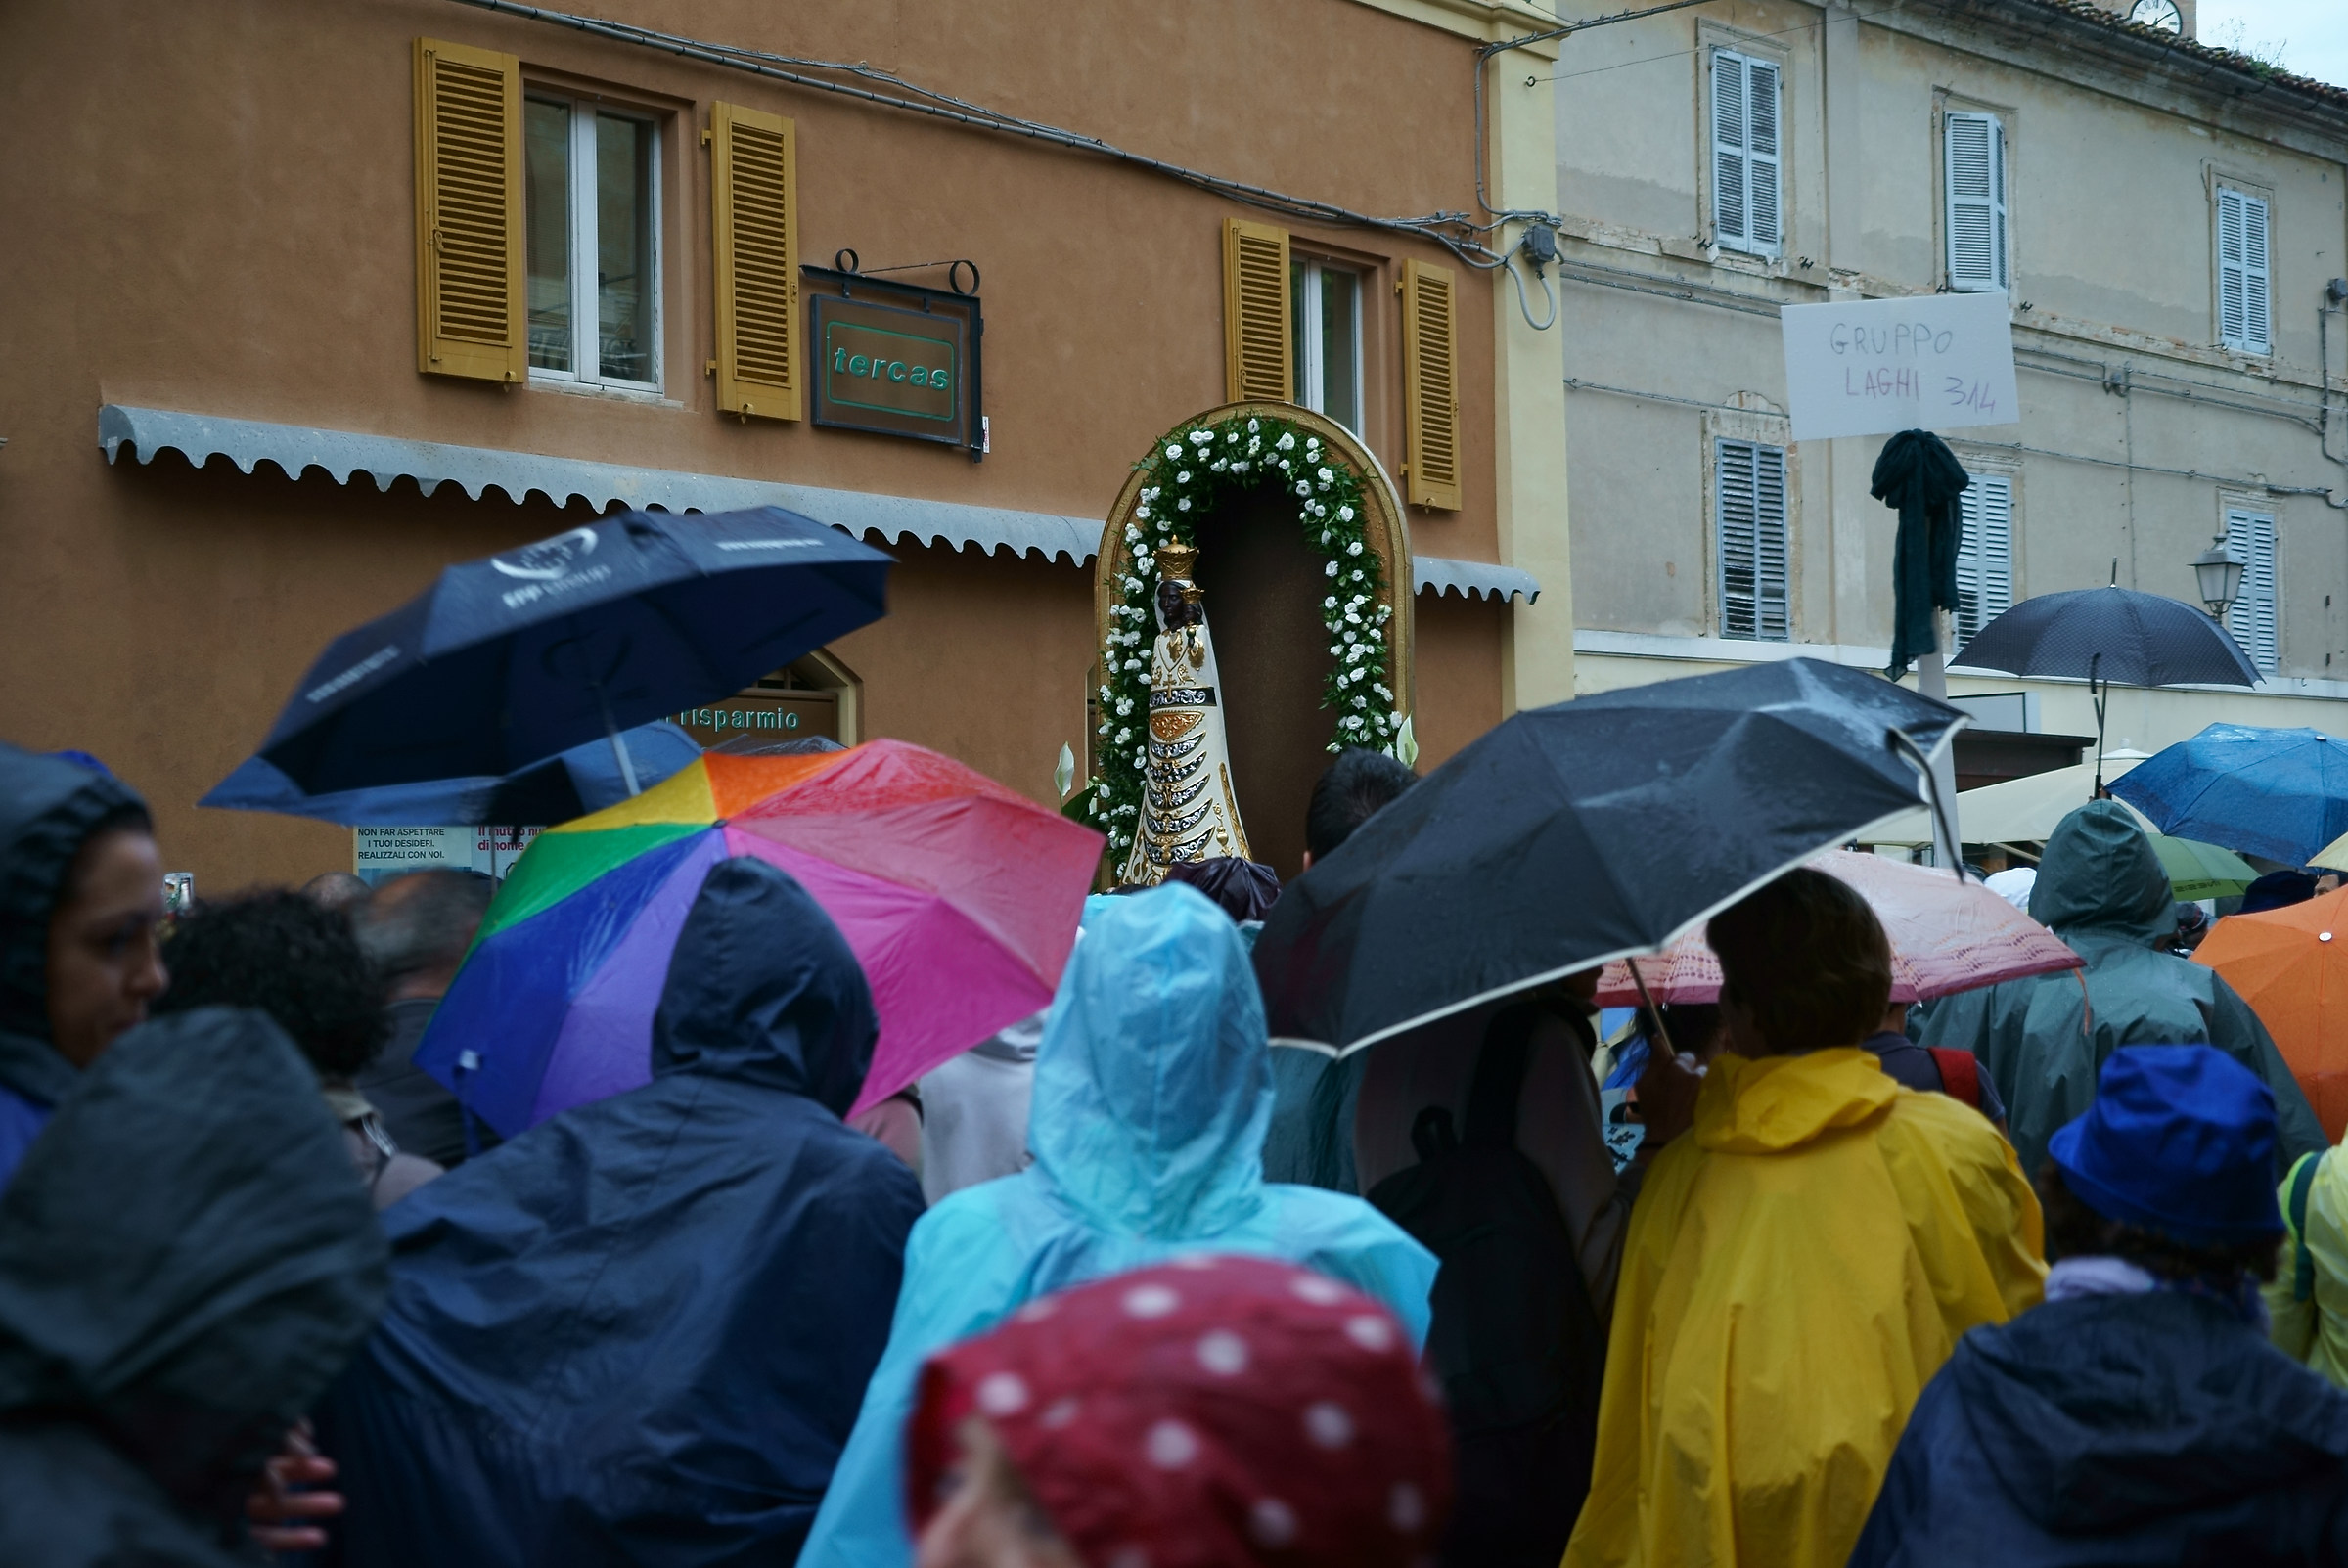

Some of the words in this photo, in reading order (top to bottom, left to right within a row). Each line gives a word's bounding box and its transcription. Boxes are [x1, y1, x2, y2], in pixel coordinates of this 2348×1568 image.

[1829, 322, 1953, 357] GRUPPO
[834, 346, 949, 391] tercas
[1845, 366, 1920, 401] LAGHI
[679, 707, 799, 733] risparmio
[358, 851, 406, 860] REALIZZALI
[395, 839, 435, 848] DESIDERI.
[477, 839, 489, 851] di
